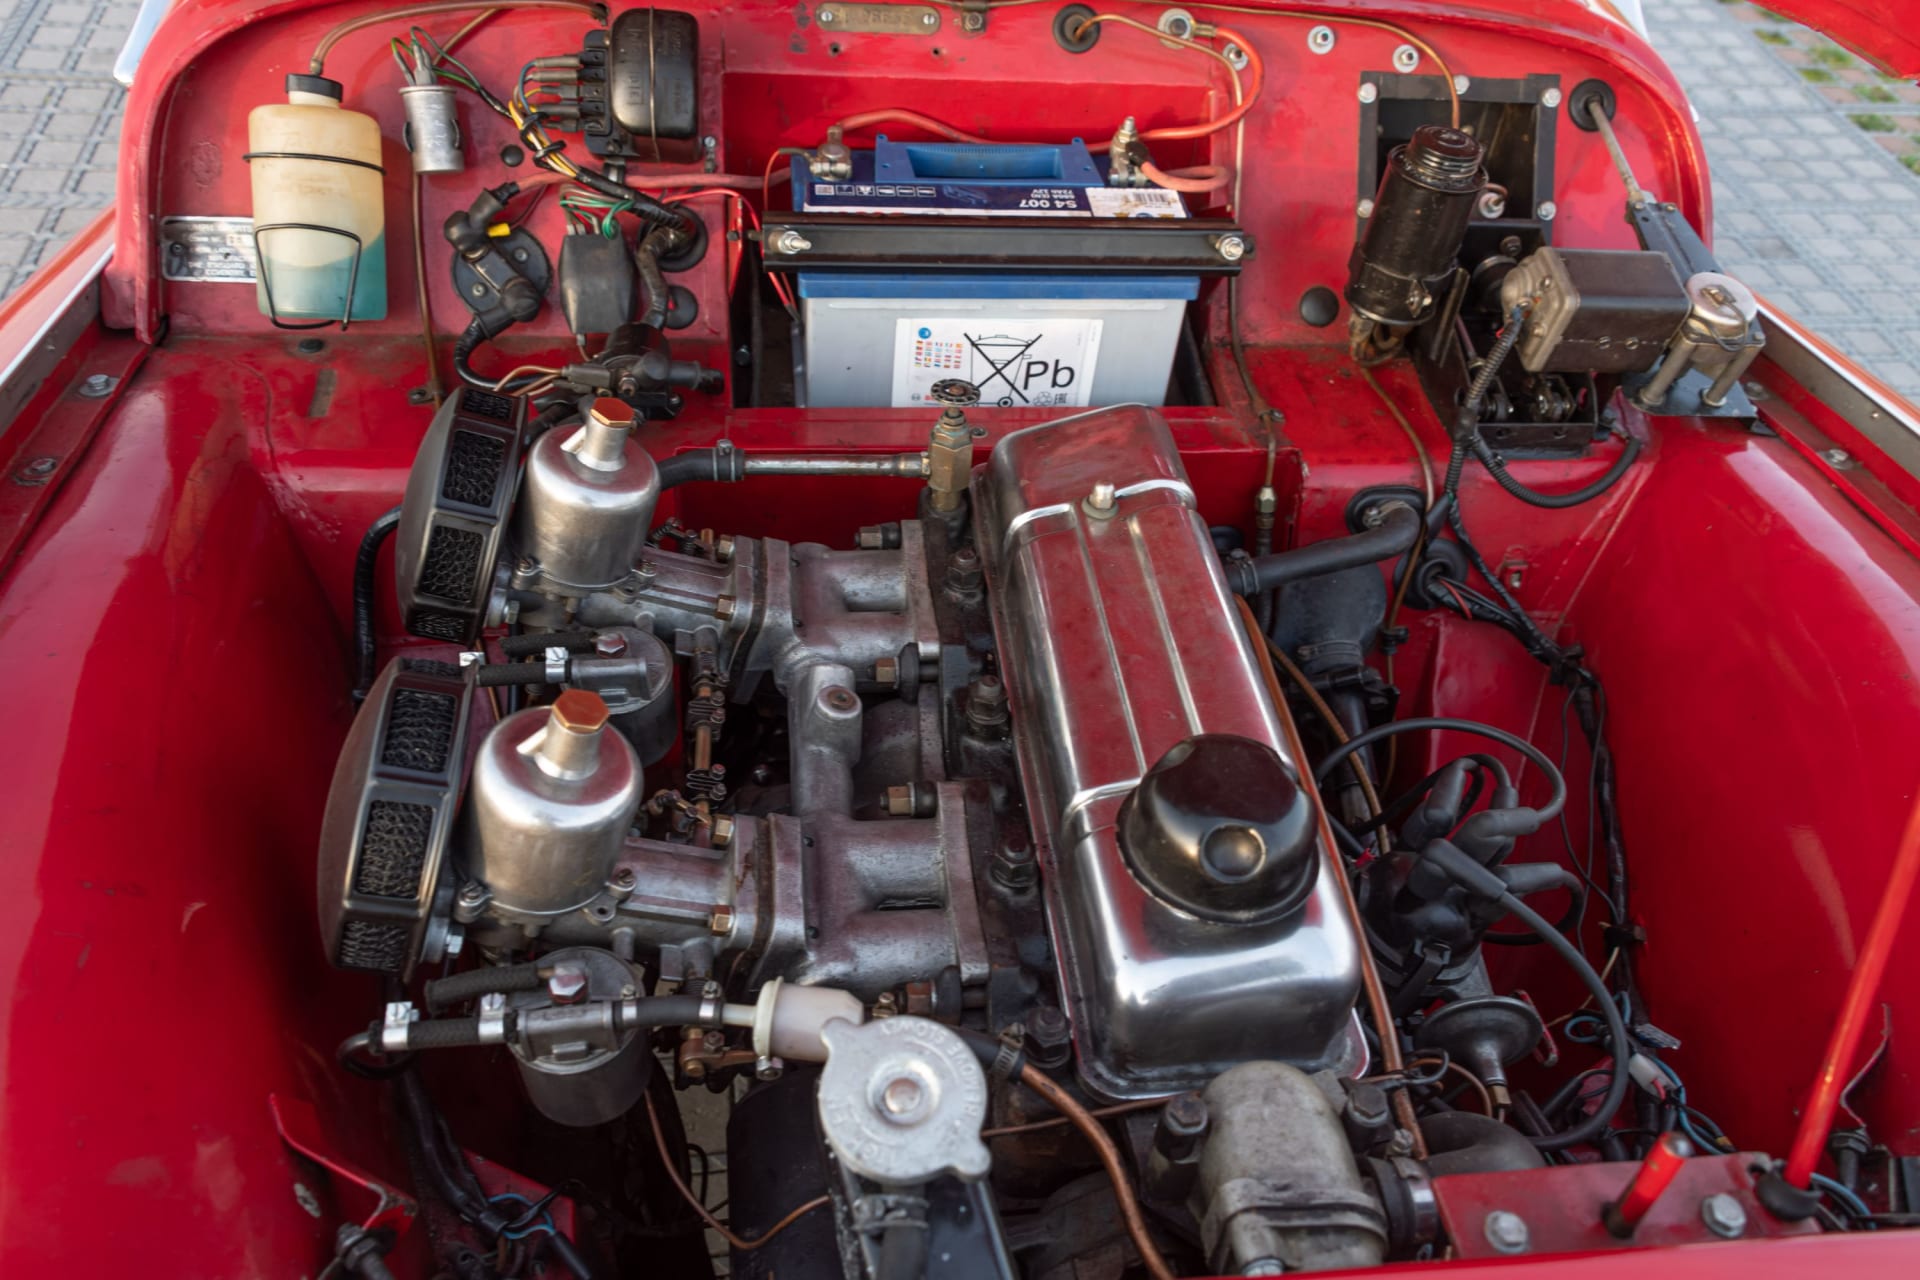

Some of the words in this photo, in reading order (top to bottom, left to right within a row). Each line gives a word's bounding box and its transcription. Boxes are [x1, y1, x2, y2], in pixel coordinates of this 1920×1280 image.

[1019, 199, 1051, 208] 007
[1054, 199, 1078, 208] S4
[1023, 359, 1075, 390] Pb
[879, 1019, 947, 1046] SLOWLY
[947, 1040, 981, 1119] REMOVE
